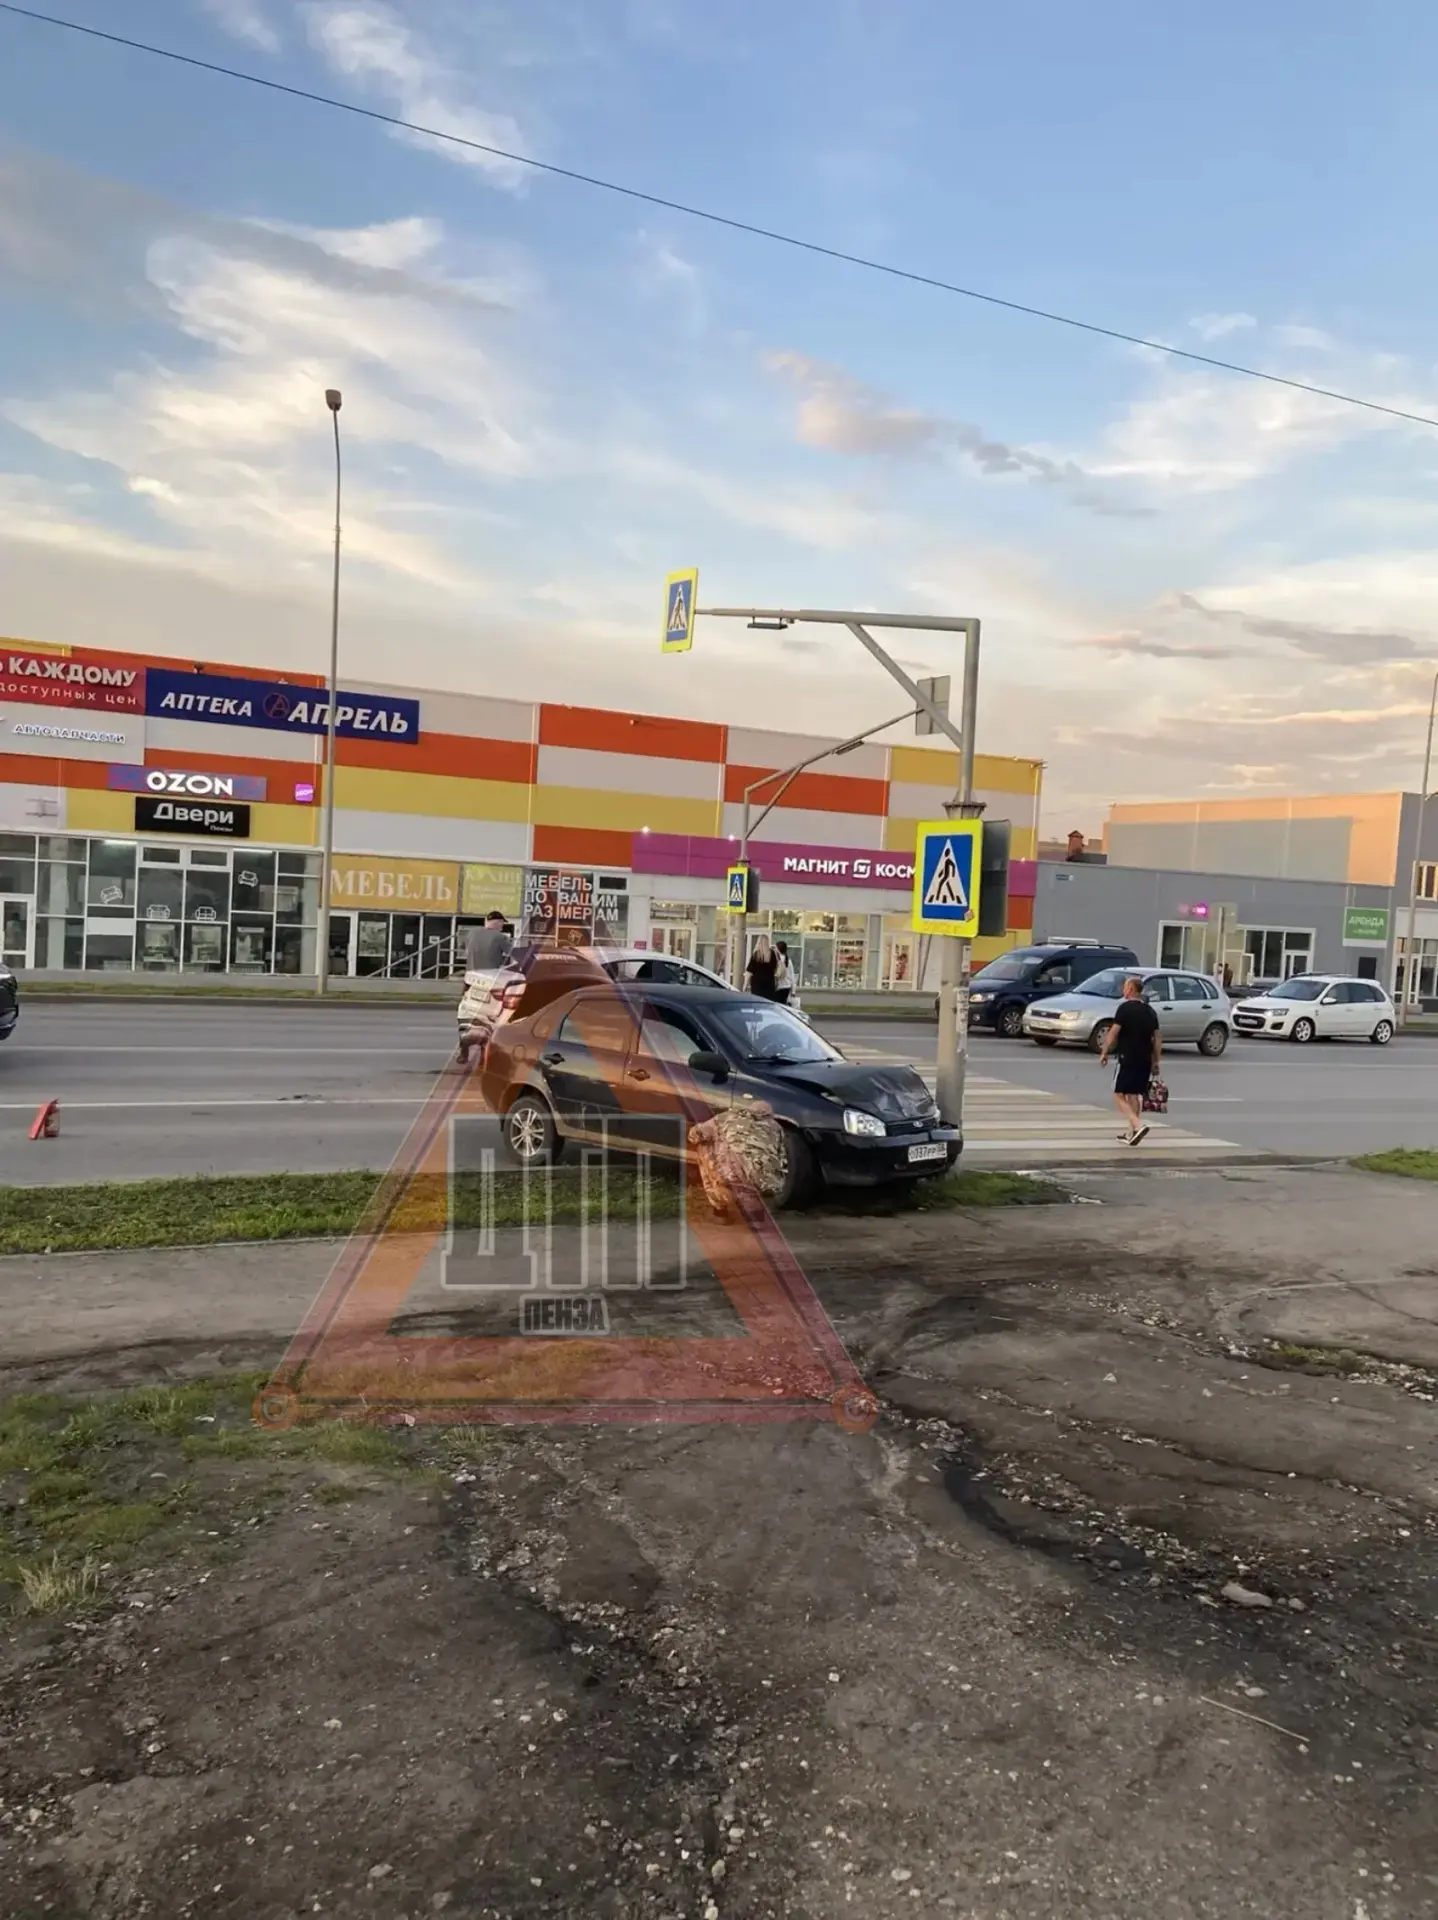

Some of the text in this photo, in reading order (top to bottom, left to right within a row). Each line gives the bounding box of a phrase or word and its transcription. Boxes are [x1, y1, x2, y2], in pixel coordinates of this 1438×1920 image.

[9, 656, 137, 687] КАЖДОМУ
[105, 694, 137, 705] цен
[160, 691, 253, 717] АПТЕКА
[287, 701, 409, 734] АПРЕЛЬ
[13, 723, 126, 744] АВТОЗАПЧАСТИ
[146, 771, 233, 796] OZON
[153, 802, 234, 826] Двери
[783, 857, 850, 875] МАГНИТ
[330, 869, 453, 901] МЕБЕЛЬ
[525, 874, 593, 891] МЕБЕЛЬ
[524, 890, 548, 904] ПО
[559, 891, 618, 908] ВАШИМ
